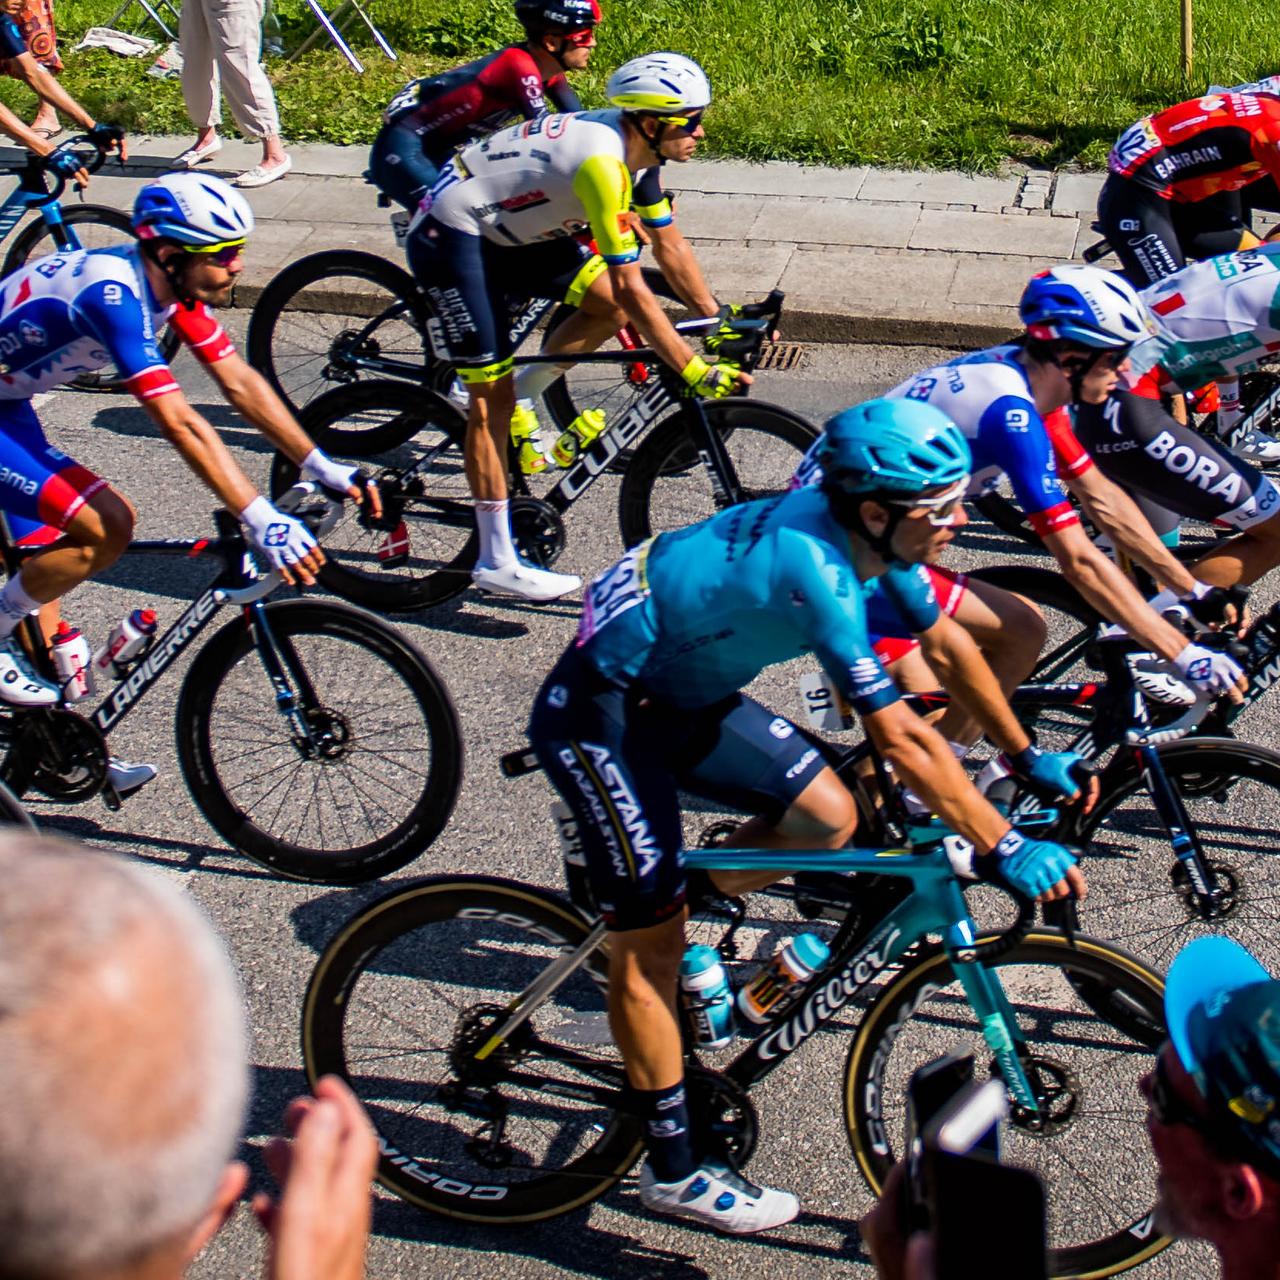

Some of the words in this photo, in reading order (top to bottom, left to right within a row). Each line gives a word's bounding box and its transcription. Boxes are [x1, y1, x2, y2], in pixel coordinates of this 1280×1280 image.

[1154, 144, 1222, 181] BAHRAIN
[559, 380, 673, 501] CUBE
[1095, 442, 1111, 455] LE
[1111, 439, 1139, 454] COL
[1144, 430, 1243, 505] BORA
[96, 588, 217, 731] LAPIERRE
[805, 687, 835, 715] 91
[579, 741, 665, 879] ASTANA
[757, 927, 902, 1062] Wilier
